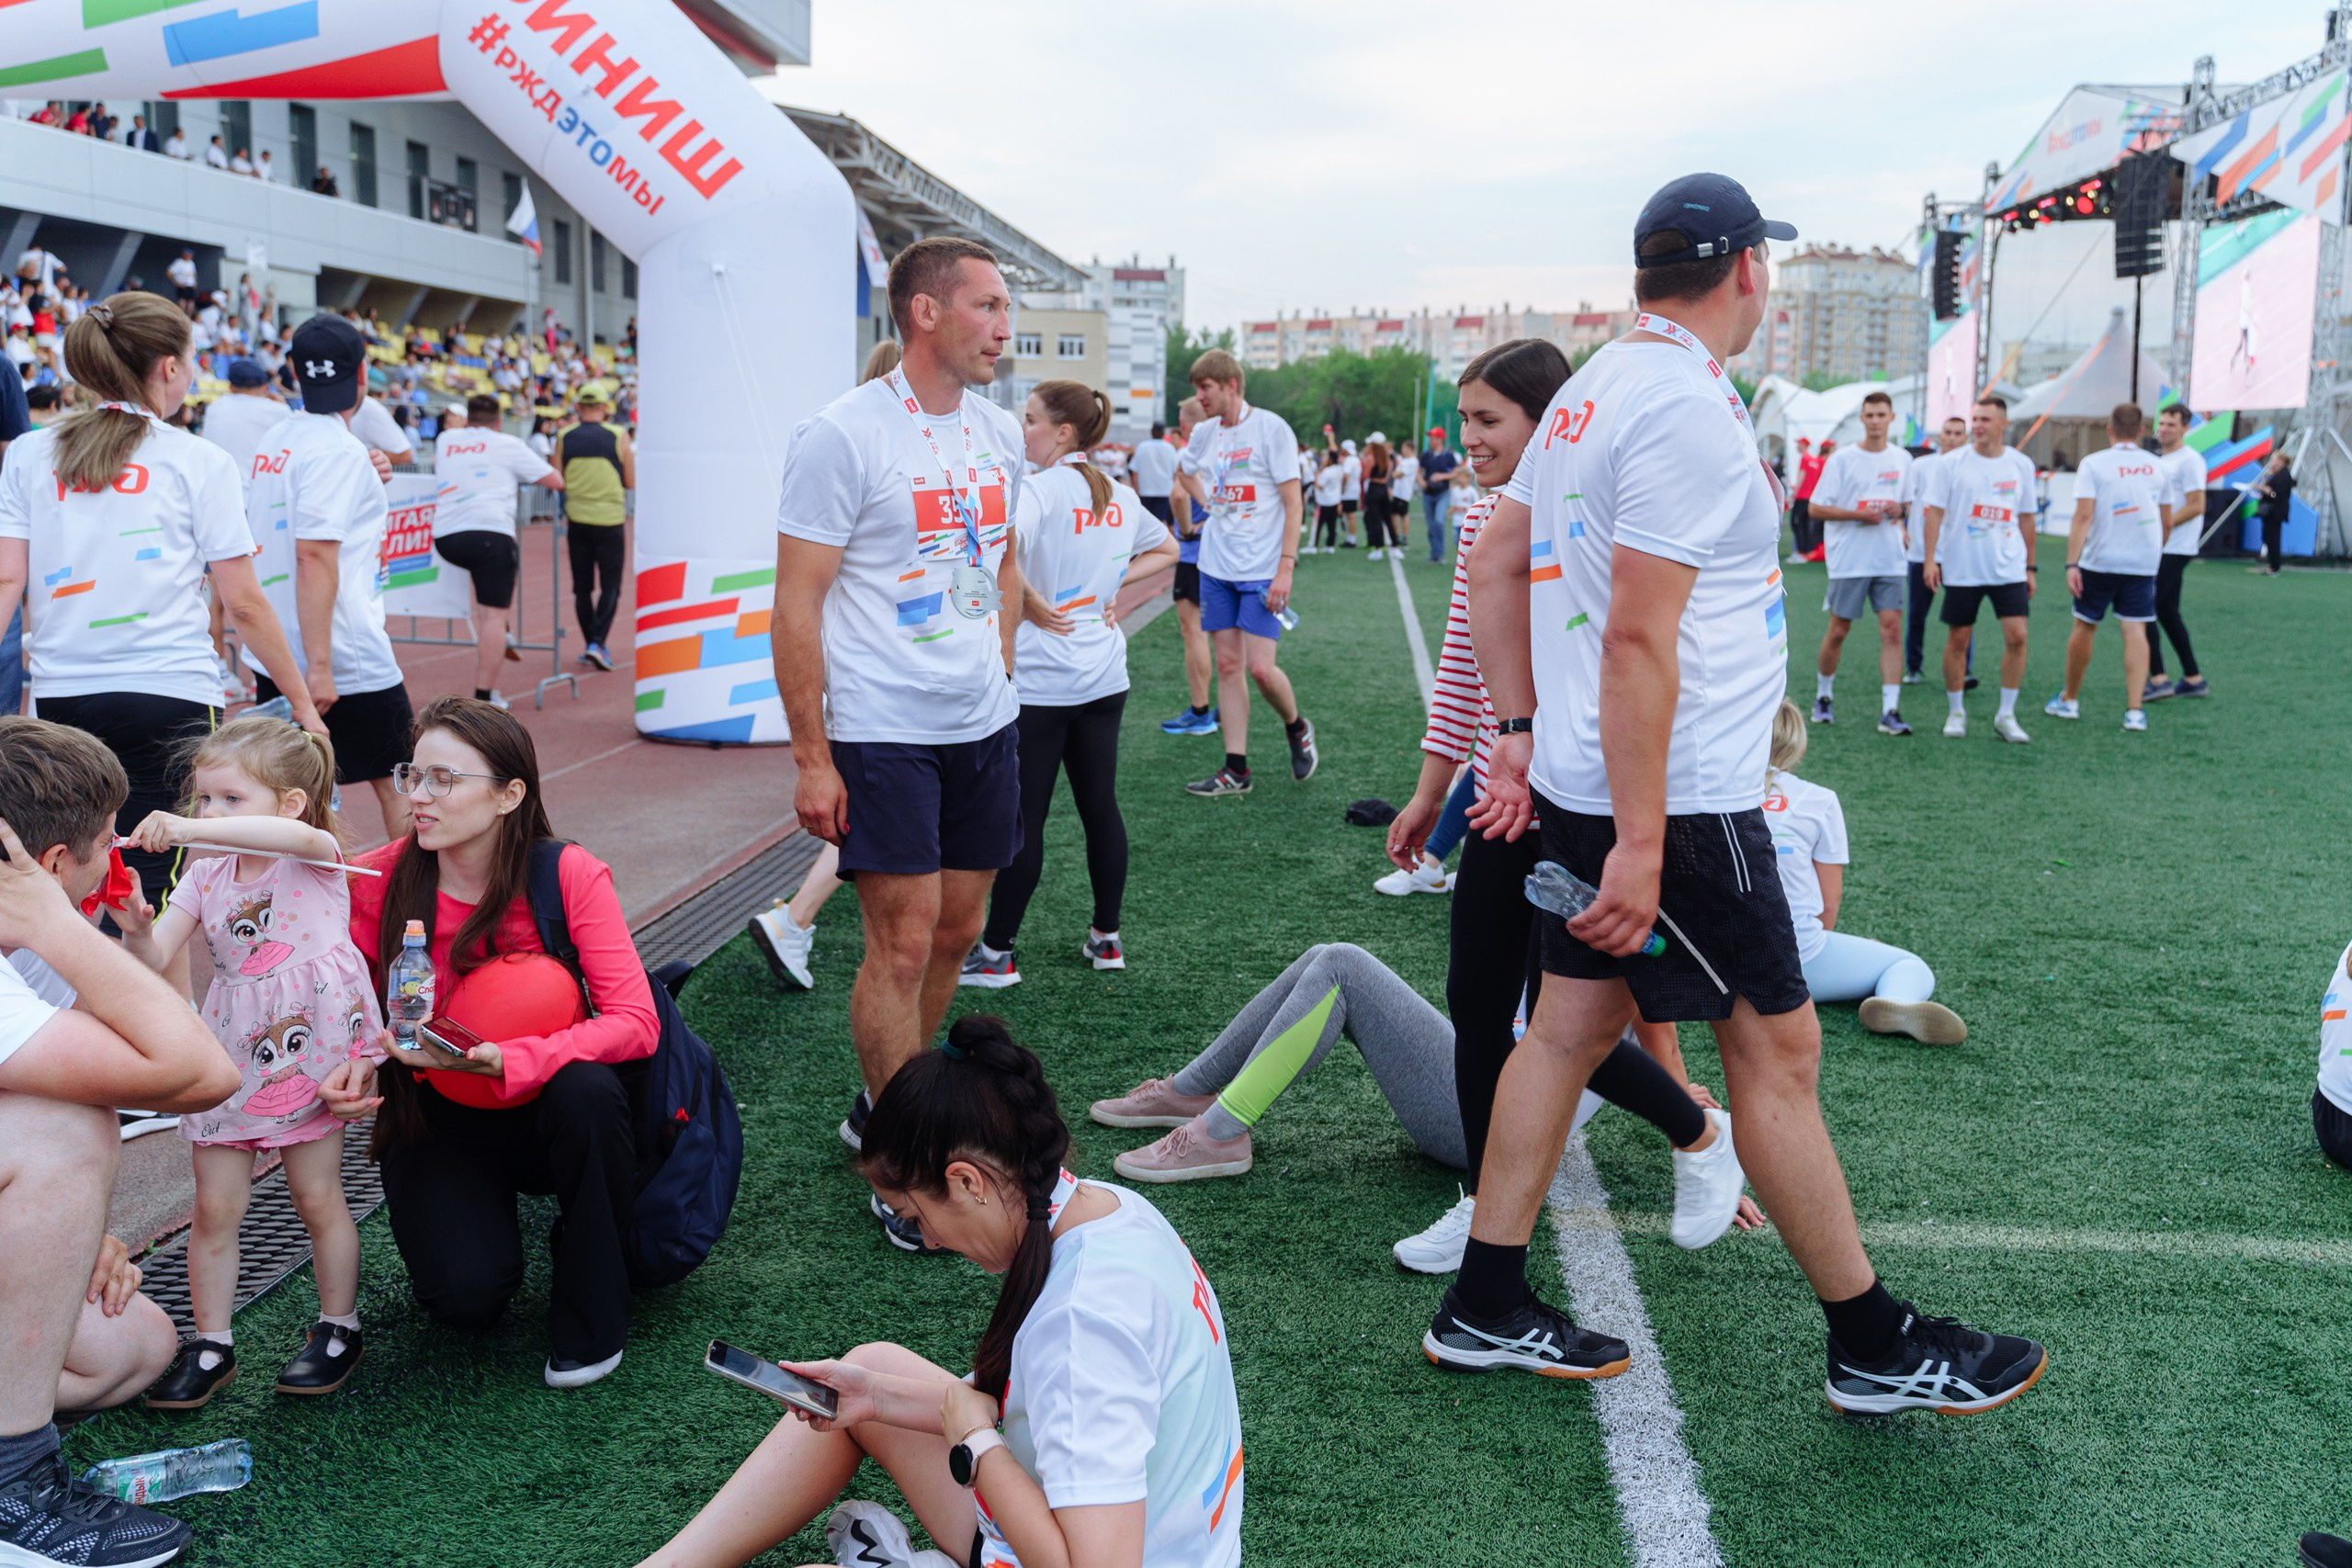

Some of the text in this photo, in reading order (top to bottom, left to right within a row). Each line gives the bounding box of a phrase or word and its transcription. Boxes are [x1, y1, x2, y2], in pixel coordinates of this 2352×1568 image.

[513, 0, 744, 200] ИНИШ
[1227, 487, 1244, 501] 67
[386, 506, 435, 533] ИГАЯ
[938, 495, 982, 525] 35
[387, 528, 430, 556] ЛИ!
